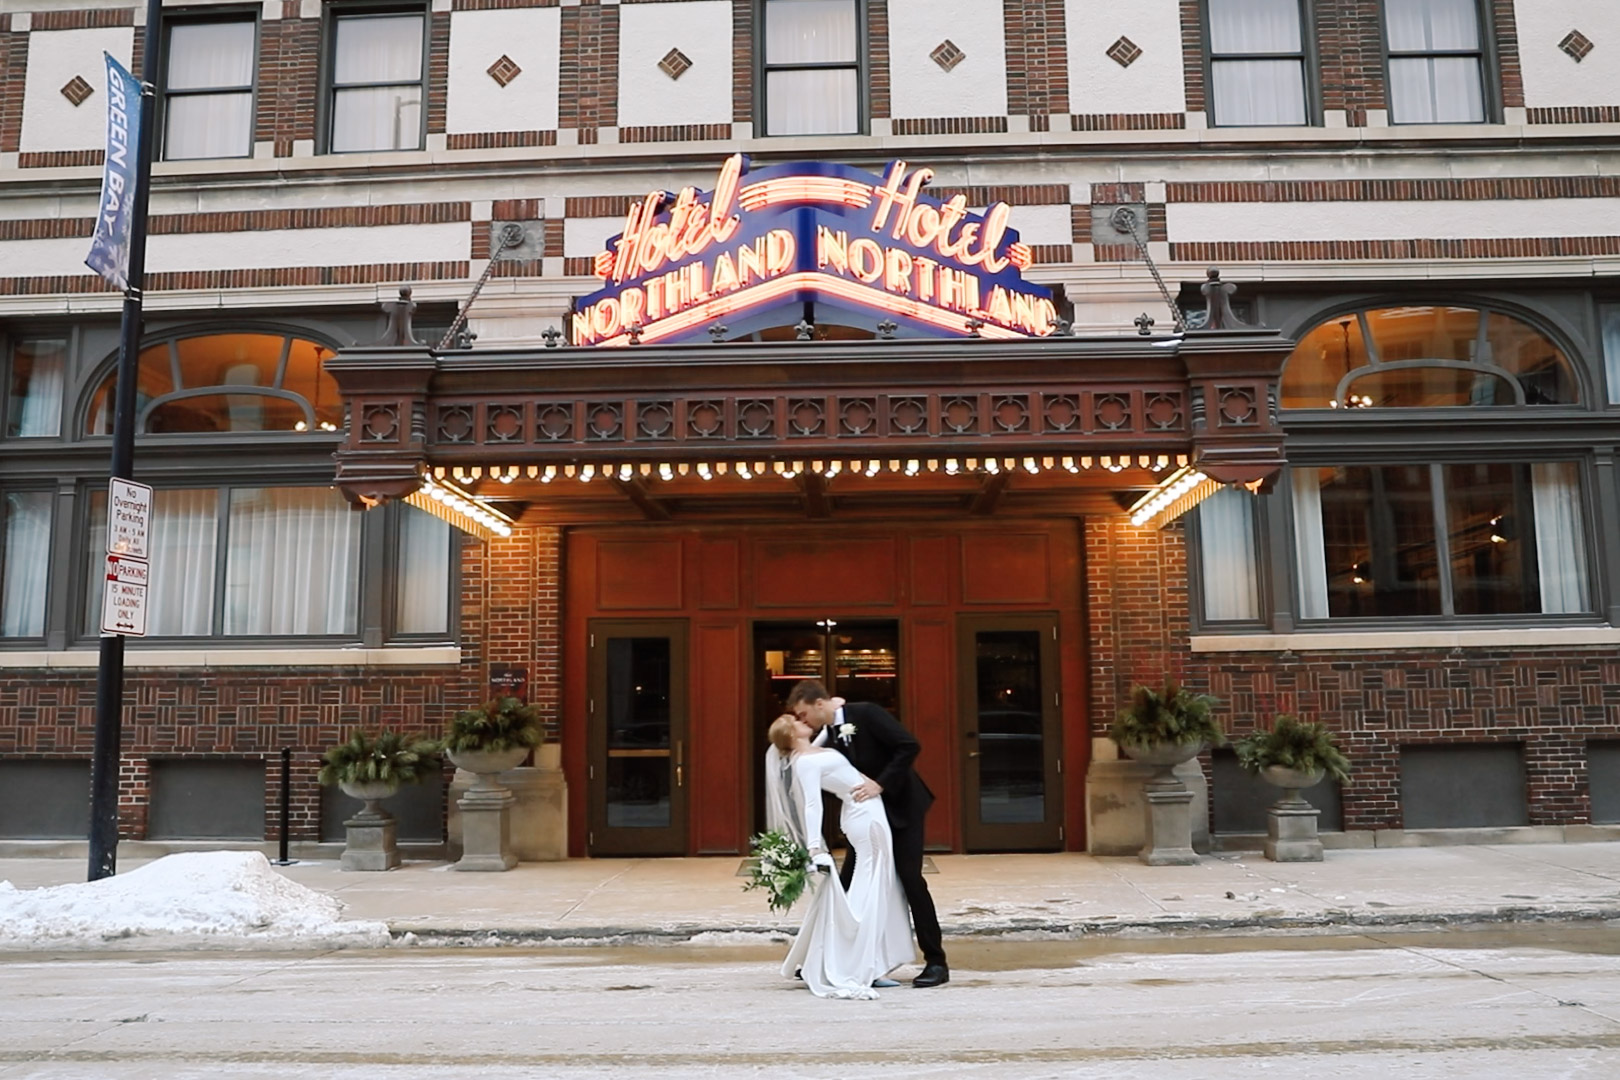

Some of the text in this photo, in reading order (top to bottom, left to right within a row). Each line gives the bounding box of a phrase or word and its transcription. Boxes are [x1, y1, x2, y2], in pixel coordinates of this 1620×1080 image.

[104, 67, 127, 236] GREEN BAY
[612, 153, 741, 286] Hotel
[871, 160, 1010, 274] Hotel
[572, 229, 796, 345] NORTHLAND
[817, 224, 1057, 337] NORTHLAND
[126, 487, 137, 498] No
[114, 496, 147, 513] Overnight
[116, 509, 144, 528] Parking
[119, 526, 127, 534] AM
[137, 529, 145, 537] AM
[119, 564, 146, 579] PARKING
[111, 584, 144, 598] 15 MINUTE
[113, 597, 140, 608] LOADING
[117, 610, 134, 620] ONLY
